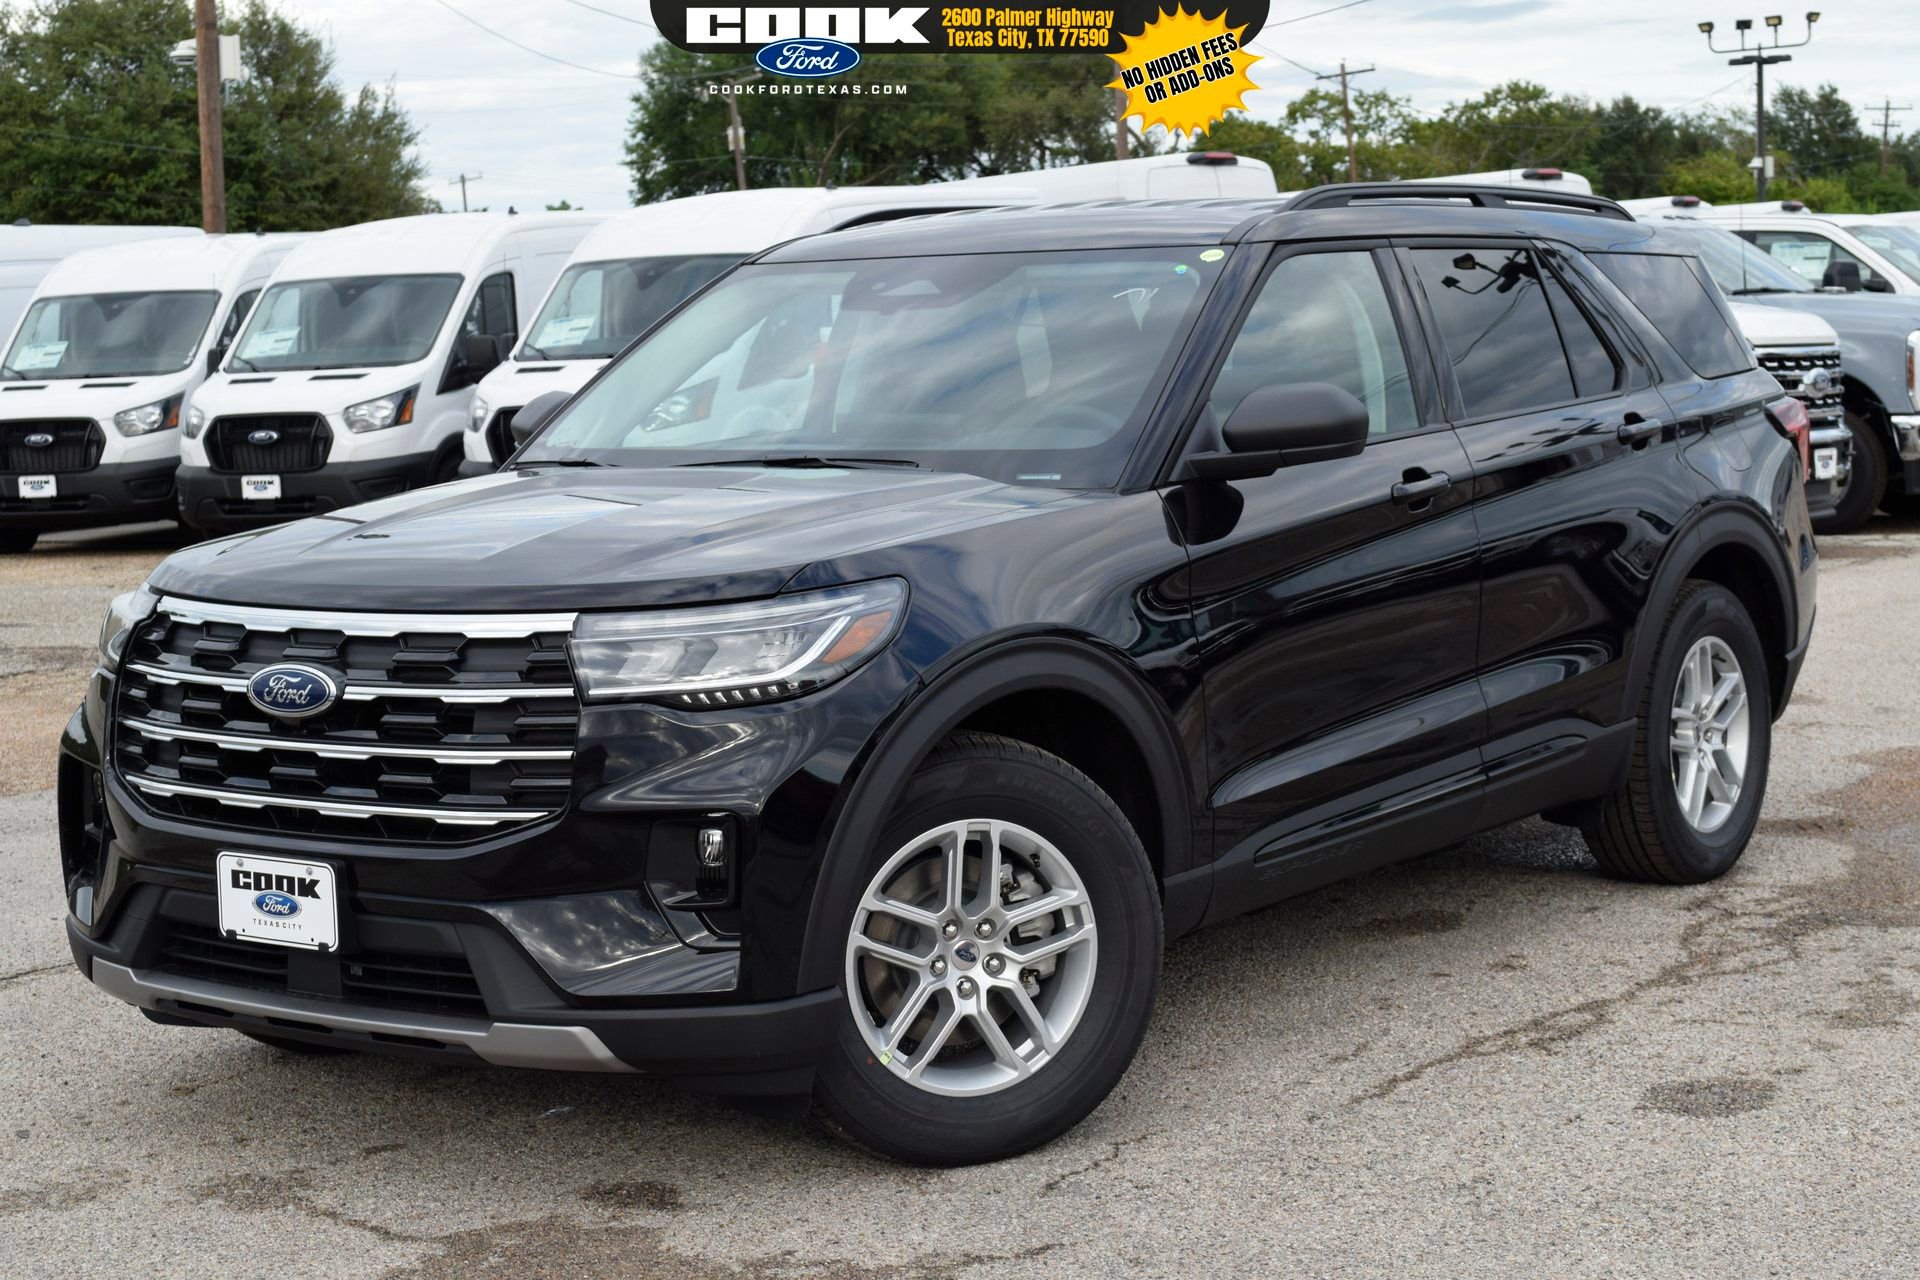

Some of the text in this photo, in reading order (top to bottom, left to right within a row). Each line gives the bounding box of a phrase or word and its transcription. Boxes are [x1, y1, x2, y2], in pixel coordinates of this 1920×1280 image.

[263, 674, 313, 704] Ford
[231, 869, 322, 900] COOK
[262, 895, 290, 914] Ford
[253, 918, 302, 931] TEXAS CITY
